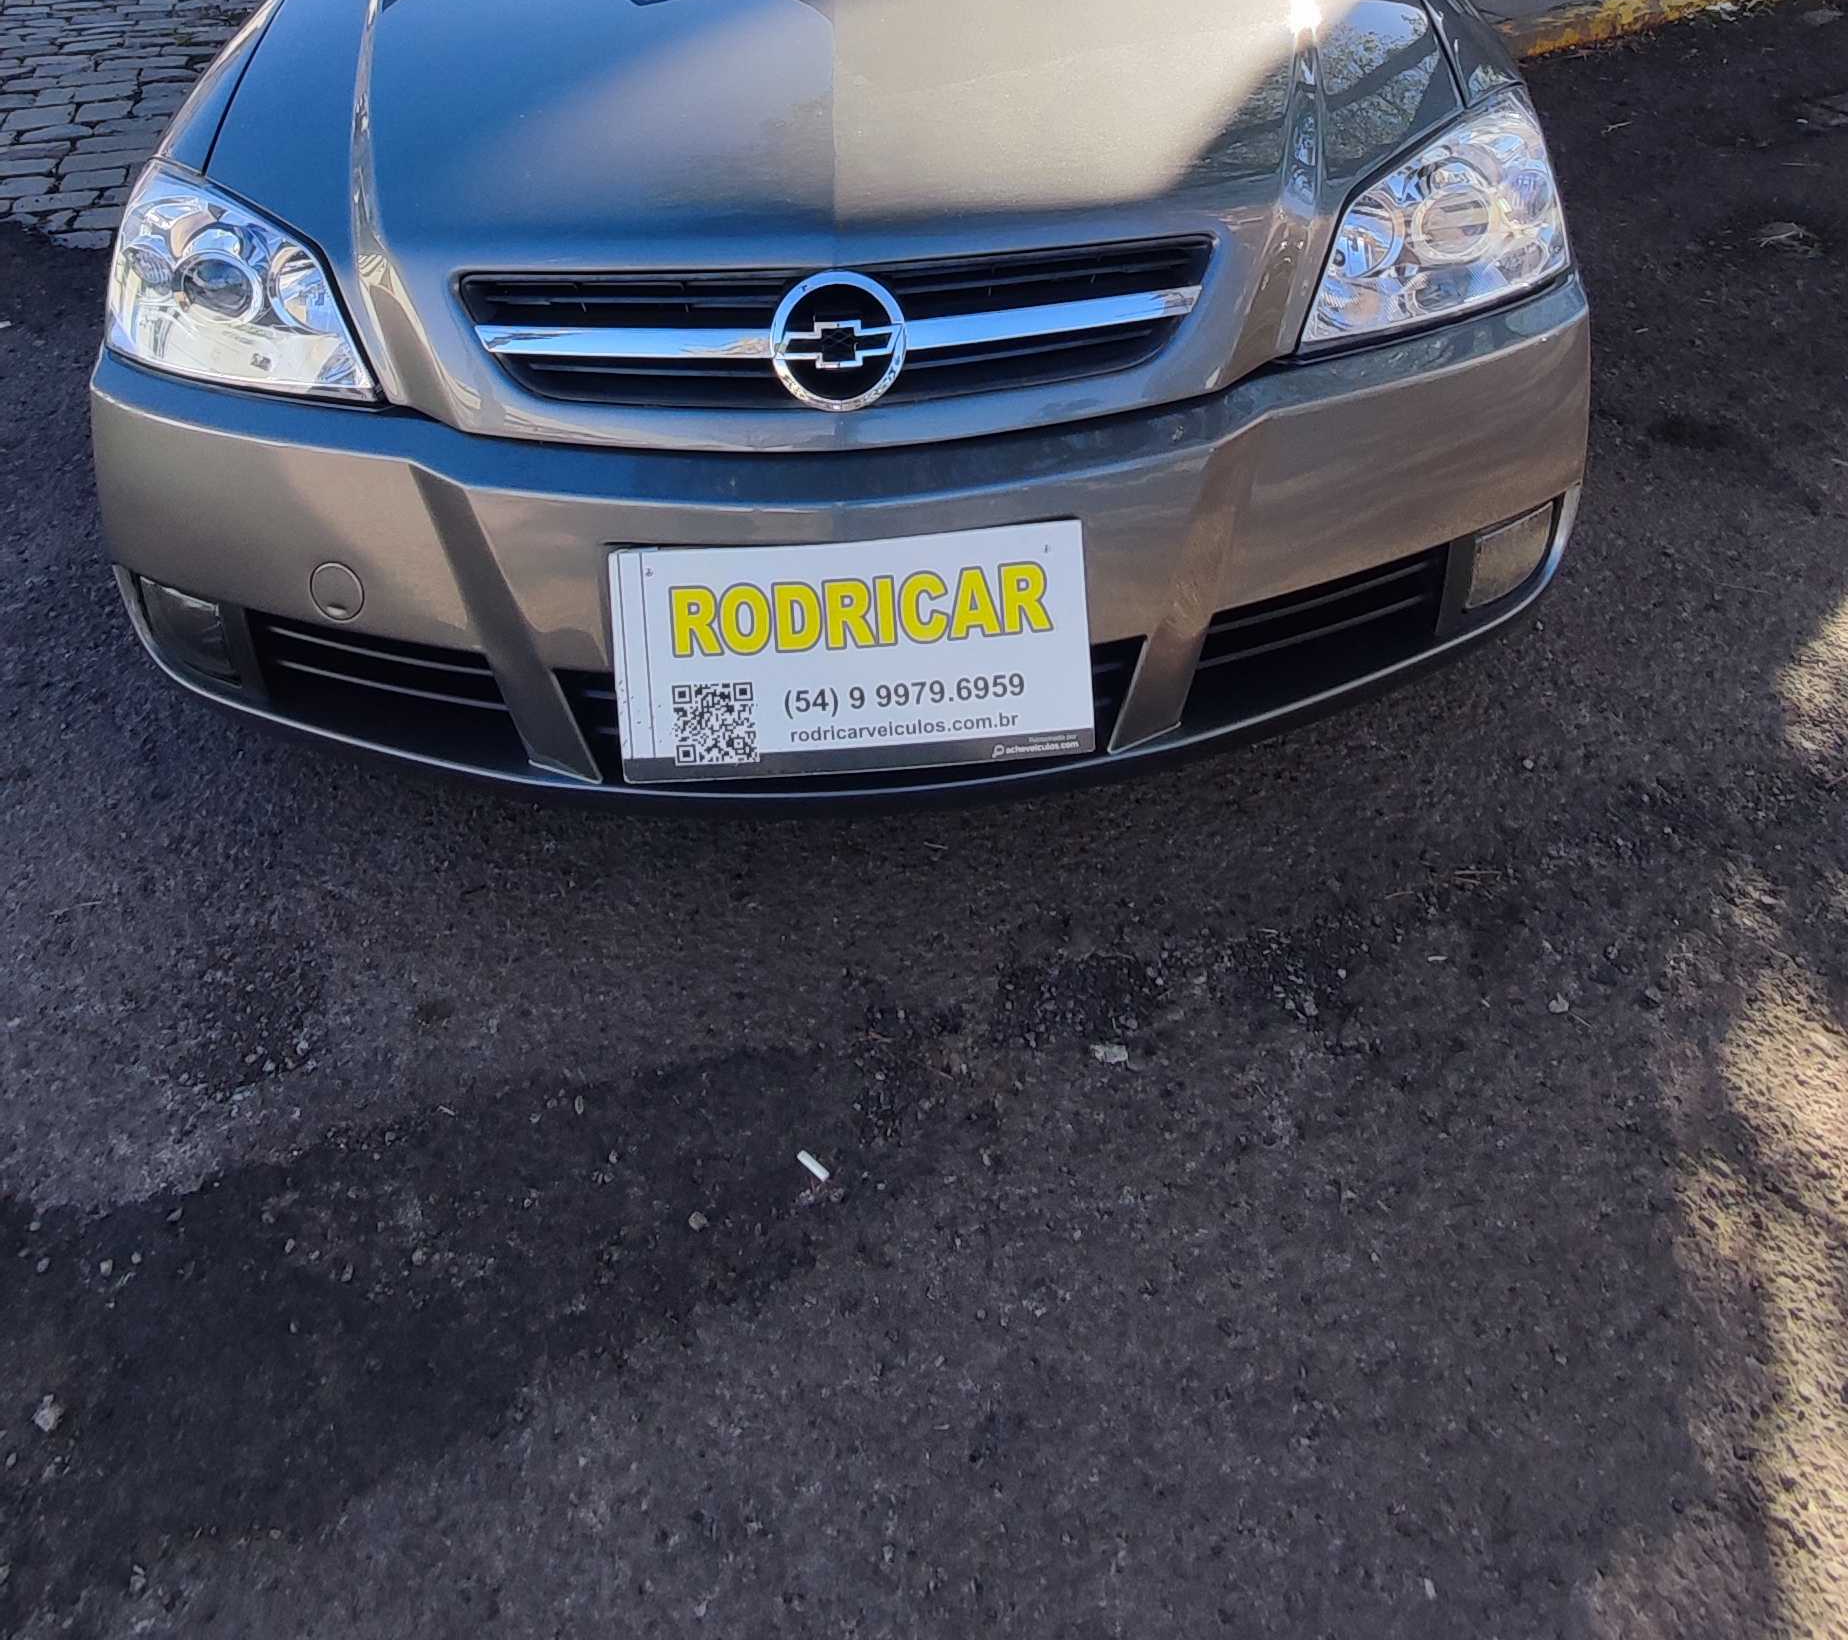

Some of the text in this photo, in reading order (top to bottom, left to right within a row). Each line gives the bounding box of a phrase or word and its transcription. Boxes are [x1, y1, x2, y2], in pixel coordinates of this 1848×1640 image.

[668, 561, 1054, 658] RODRICAR
[784, 673, 1025, 719] (54) 9 9979.6959
[790, 712, 1019, 743] rodricarveiculos.com.br
